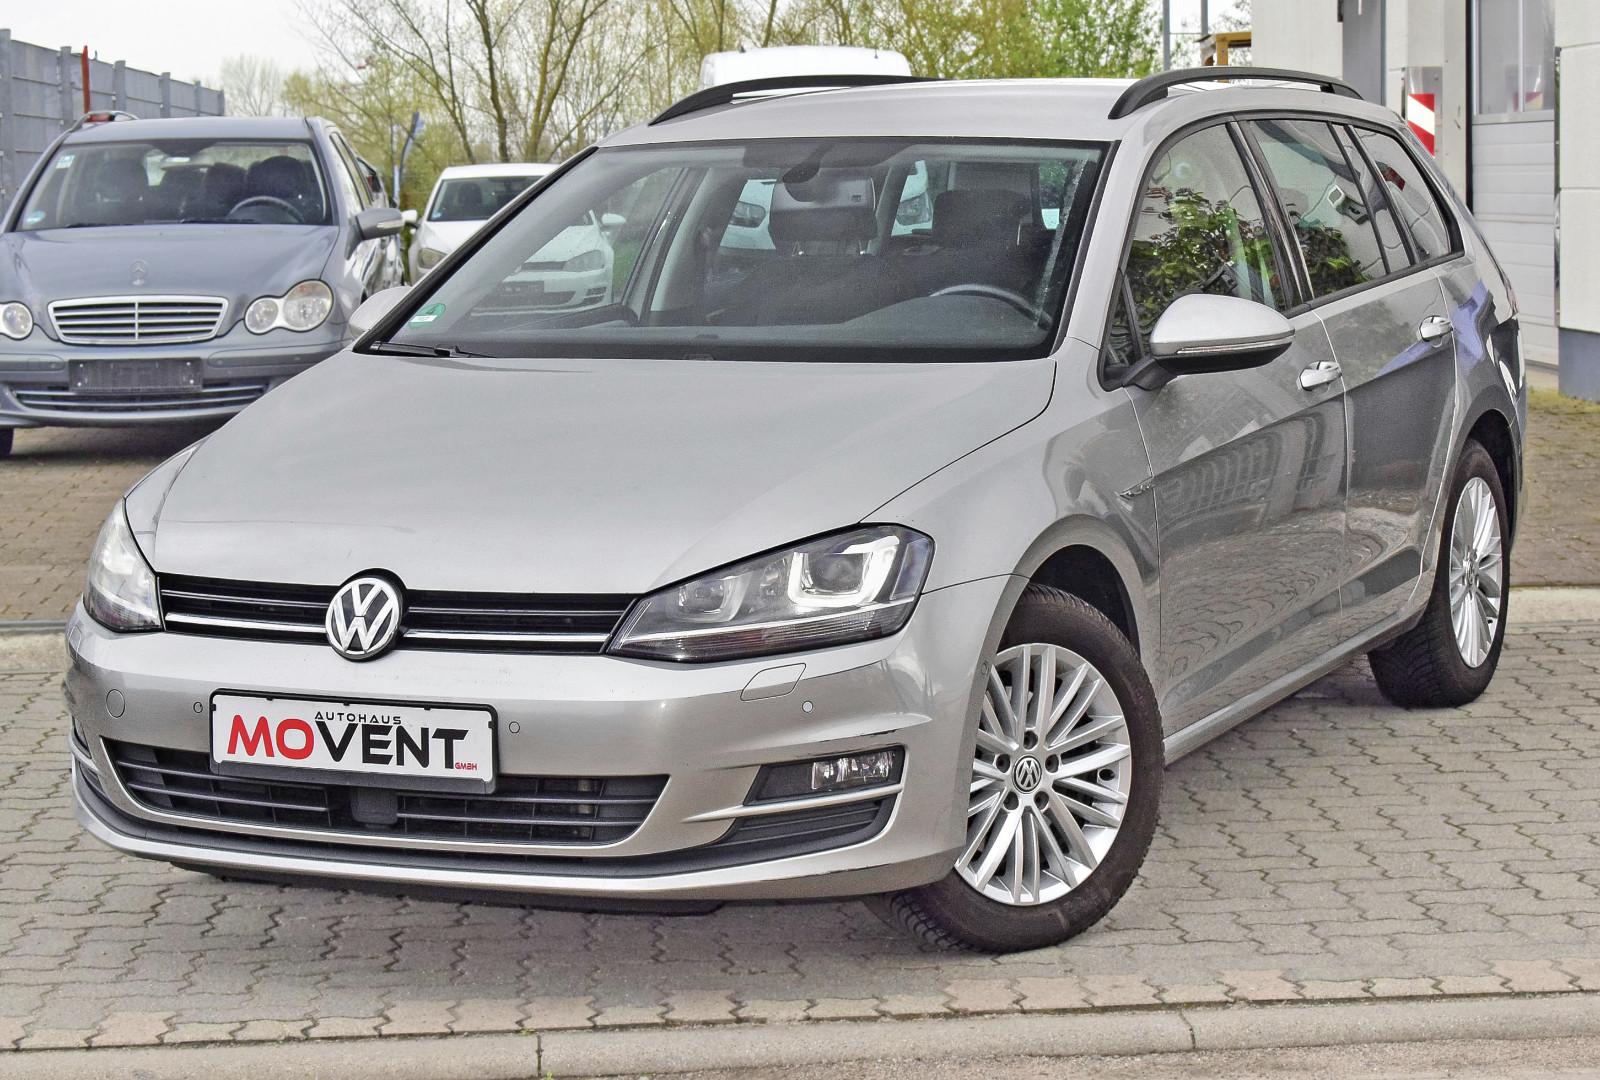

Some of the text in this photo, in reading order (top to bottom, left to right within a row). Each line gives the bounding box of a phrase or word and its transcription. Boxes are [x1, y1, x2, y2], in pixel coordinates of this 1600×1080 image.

[325, 577, 400, 655] VW
[227, 714, 469, 769] MOVENT
[314, 711, 402, 725] AUTOHAUS
